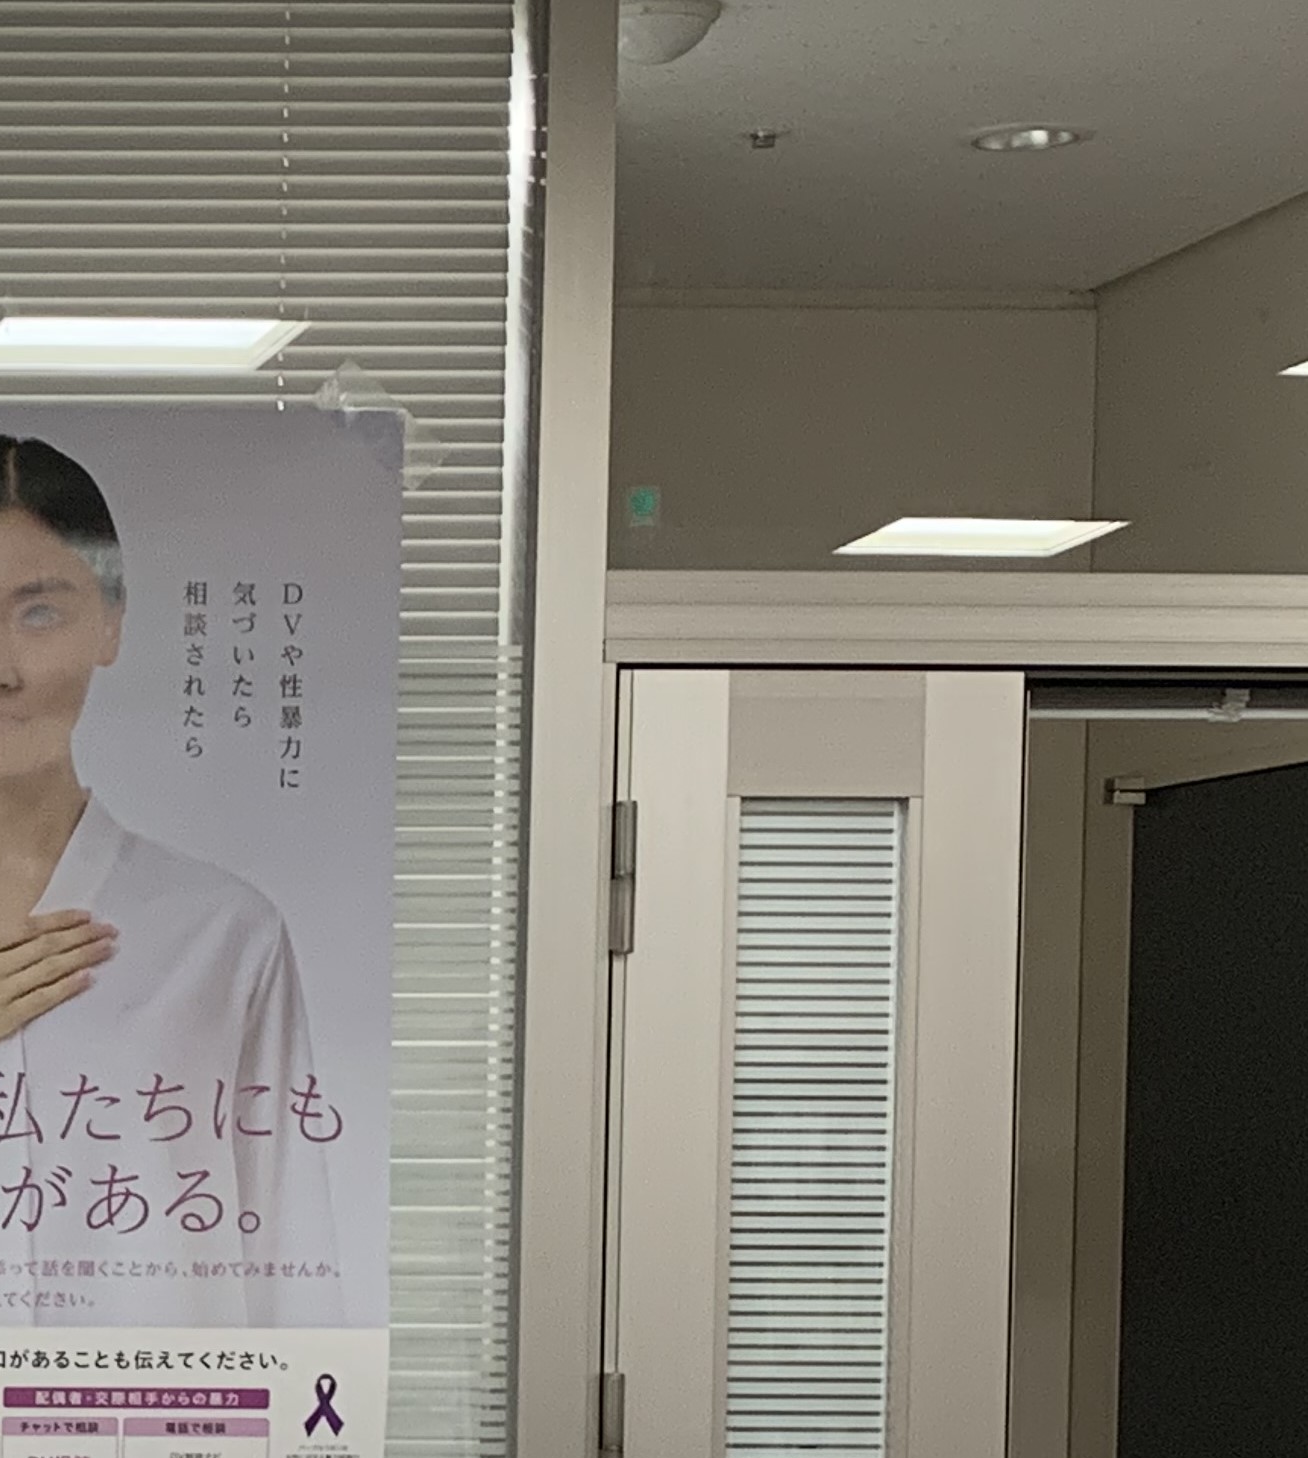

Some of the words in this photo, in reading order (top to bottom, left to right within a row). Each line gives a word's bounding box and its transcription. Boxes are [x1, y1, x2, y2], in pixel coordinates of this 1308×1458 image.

[183, 580, 207, 759] 相談されたら
[231, 581, 256, 728] 気づいたら
[278, 581, 304, 789] DVや性暴力に
